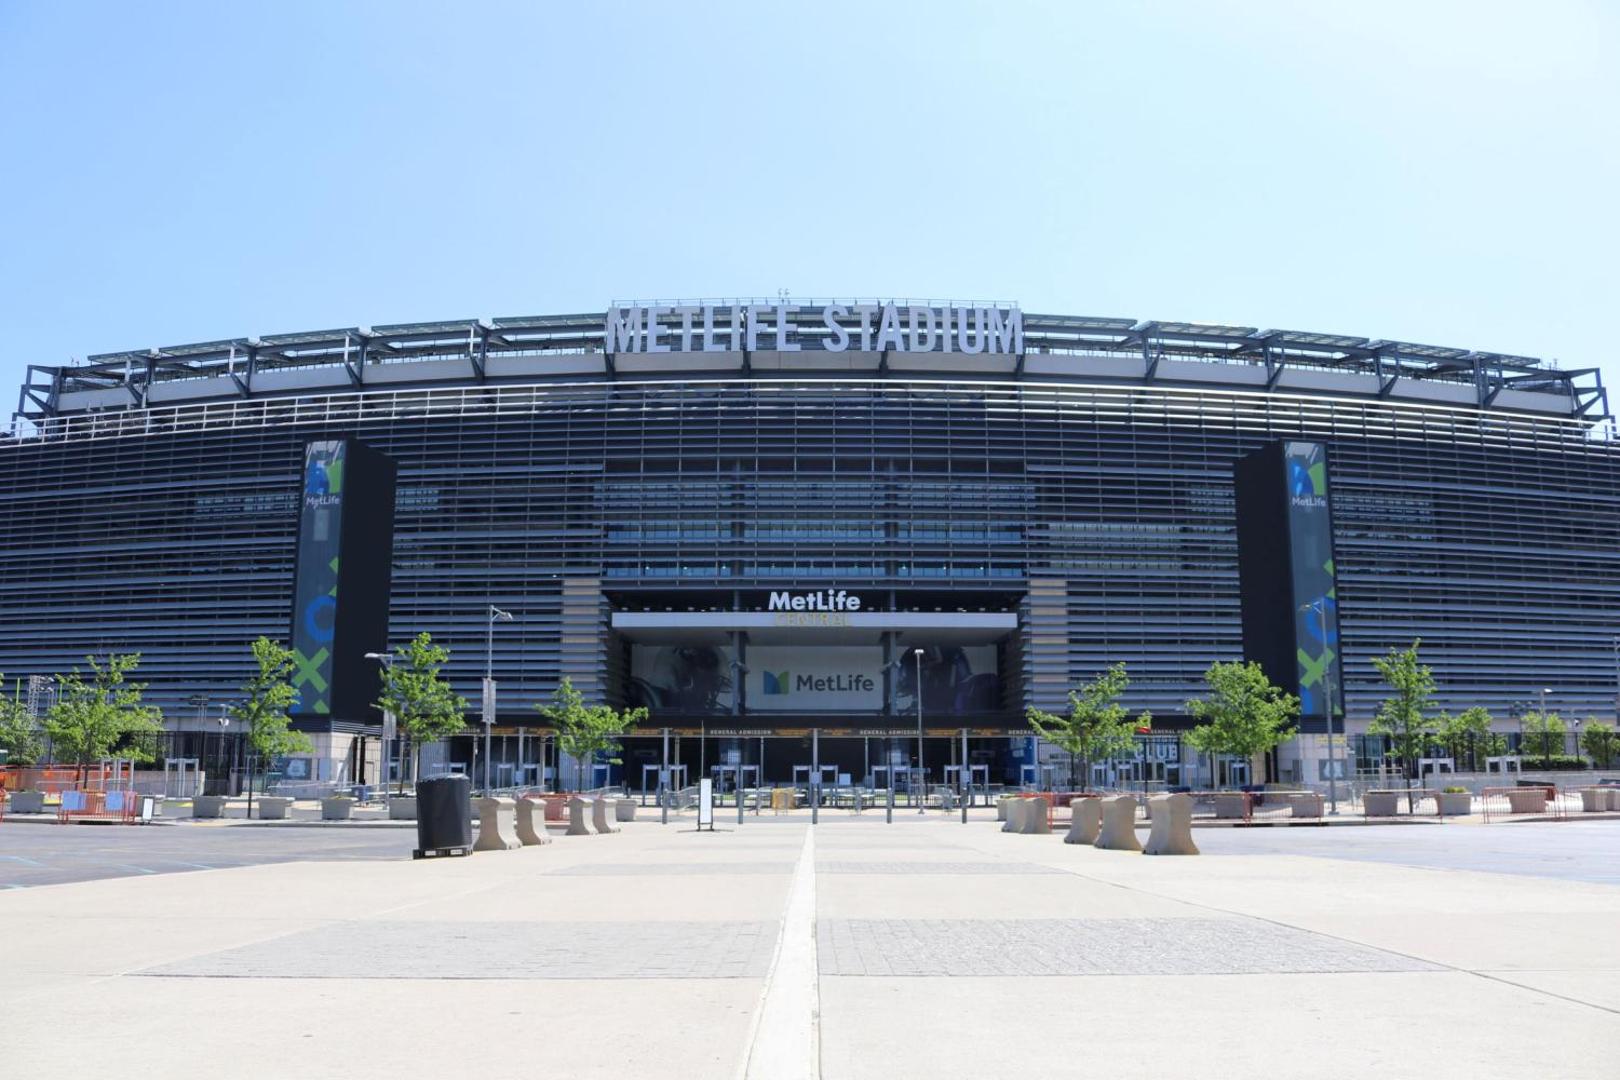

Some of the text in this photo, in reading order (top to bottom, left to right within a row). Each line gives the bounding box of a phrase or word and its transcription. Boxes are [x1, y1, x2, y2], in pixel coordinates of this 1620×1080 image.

[606, 303, 1024, 355] METLIFE STADIUM
[1291, 496, 1326, 506] MetLife
[768, 589, 861, 610] MetLife
[775, 612, 851, 627] CENTRAL
[796, 674, 874, 692] MetLife
